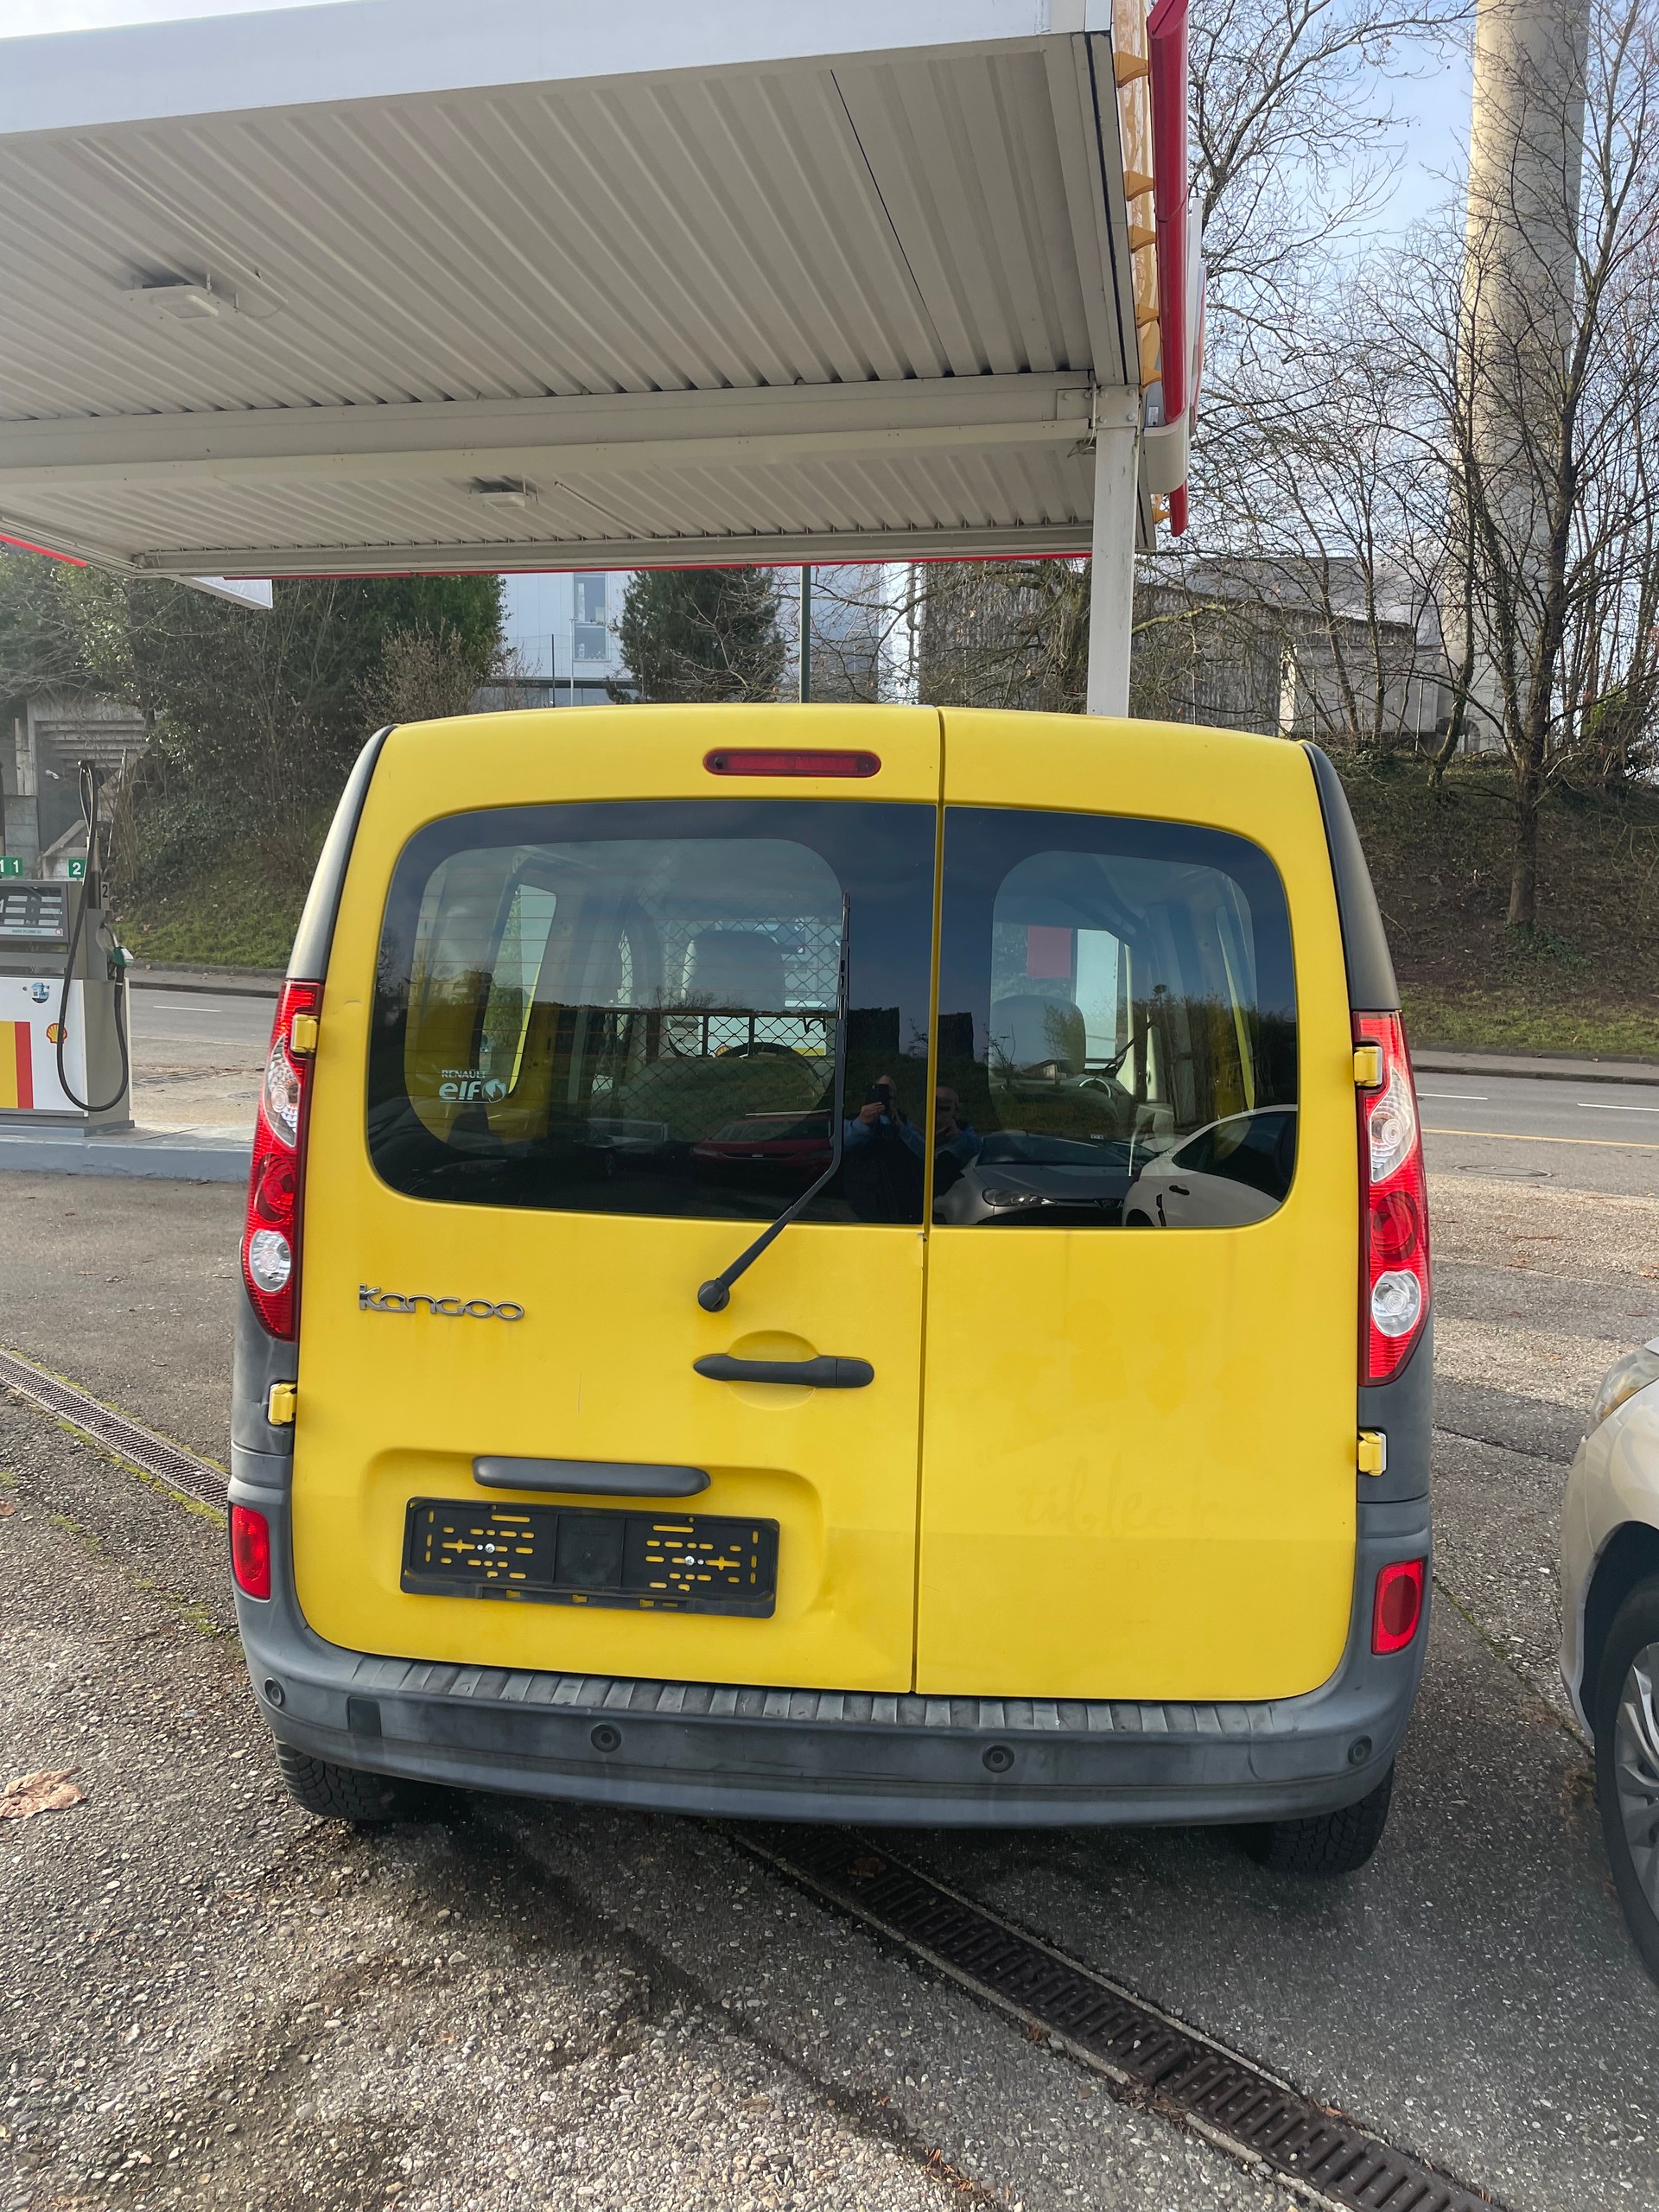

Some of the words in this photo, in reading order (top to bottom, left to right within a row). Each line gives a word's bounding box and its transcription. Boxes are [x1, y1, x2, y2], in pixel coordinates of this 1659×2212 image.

[13, 860, 19, 874] 1
[72, 862, 82, 875] 2
[102, 884, 108, 899] 2
[442, 1069, 487, 1079] RENAULT
[439, 1080, 481, 1100] elf
[359, 1282, 525, 1321] Kangoo
